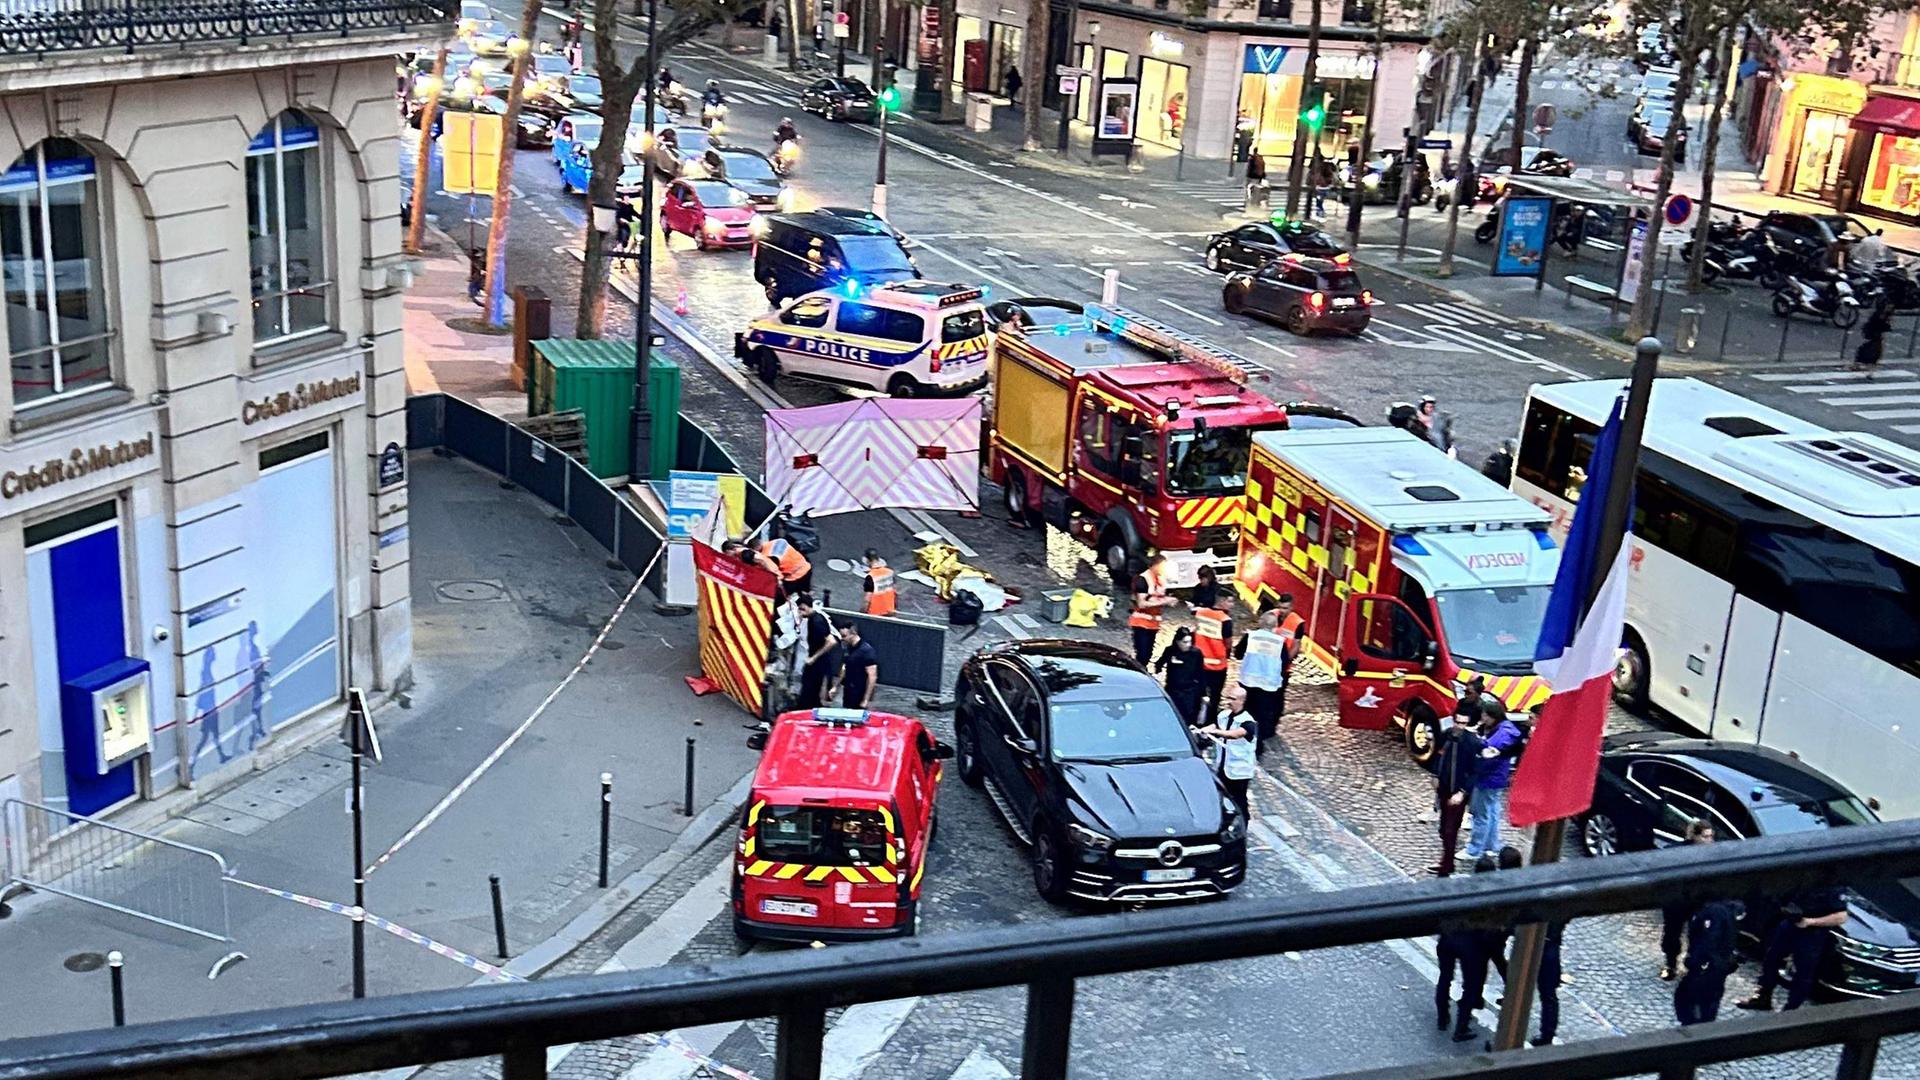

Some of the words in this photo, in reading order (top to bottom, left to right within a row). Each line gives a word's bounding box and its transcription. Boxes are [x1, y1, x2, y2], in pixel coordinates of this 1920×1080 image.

[804, 338, 871, 363] POLICE
[308, 371, 361, 405] Mutuel
[87, 431, 154, 473] Mutuel
